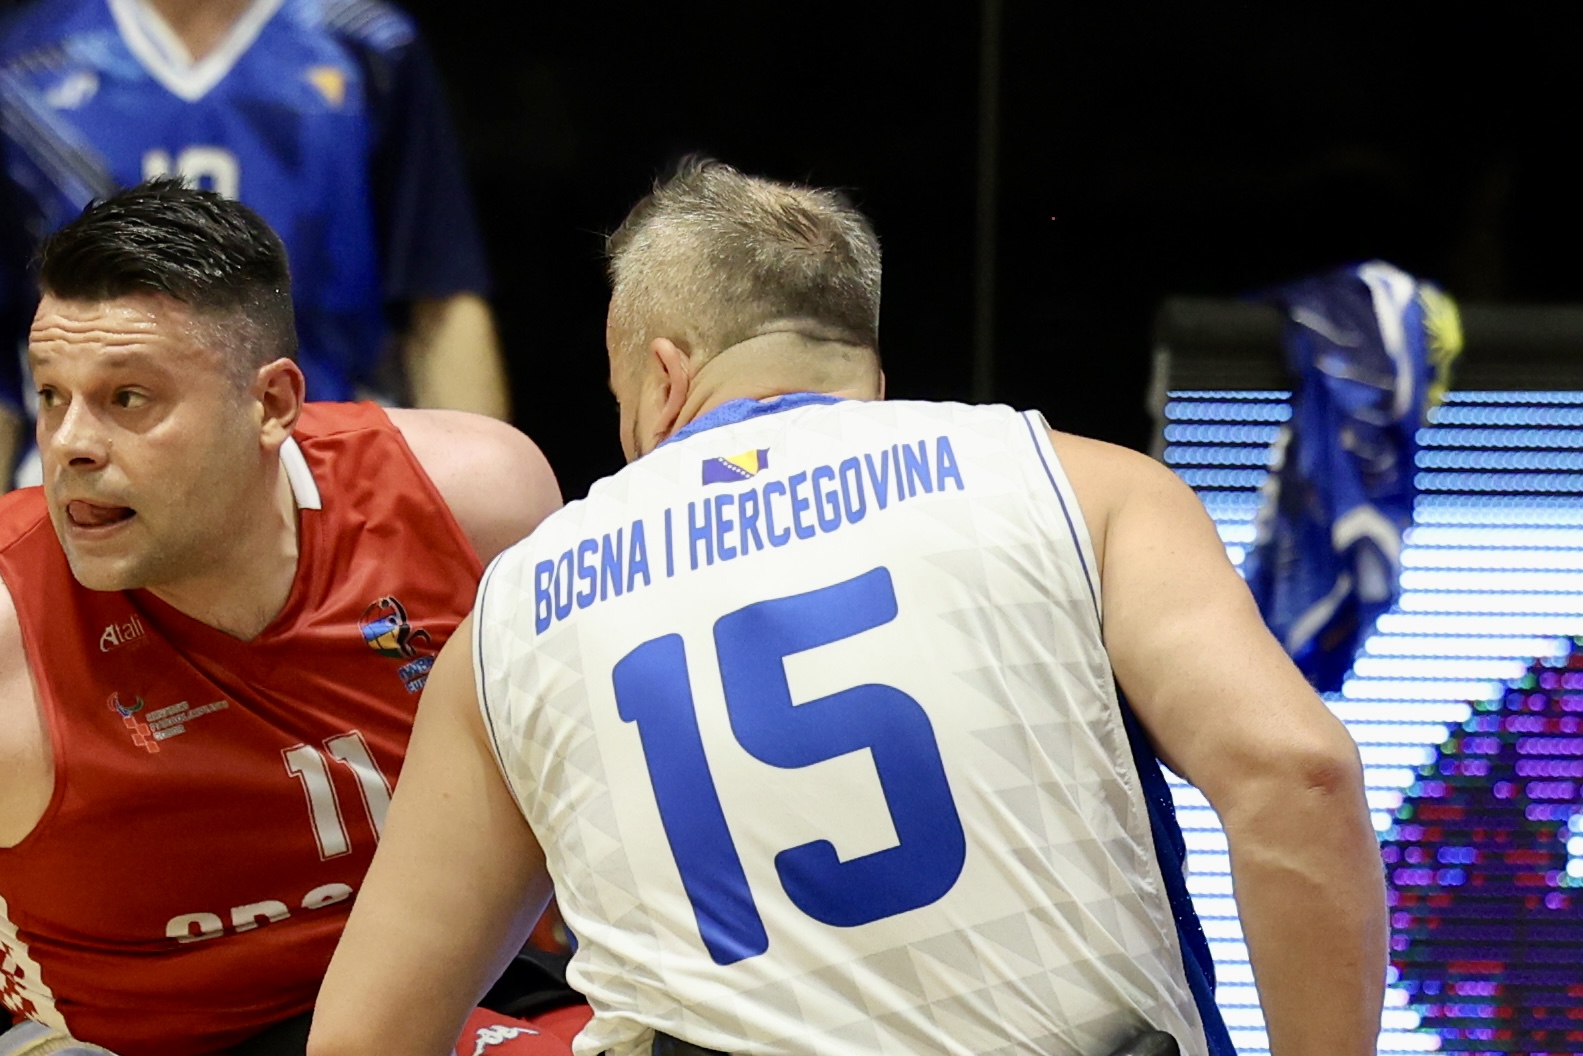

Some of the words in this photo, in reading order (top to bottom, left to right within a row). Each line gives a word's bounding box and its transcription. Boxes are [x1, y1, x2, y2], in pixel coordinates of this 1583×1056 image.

[534, 518, 651, 637] BOSNA
[664, 507, 676, 579] I
[688, 434, 966, 572] HERCEGOVINA
[99, 614, 146, 653] Atali
[281, 729, 393, 861] 11
[611, 565, 967, 967] 15
